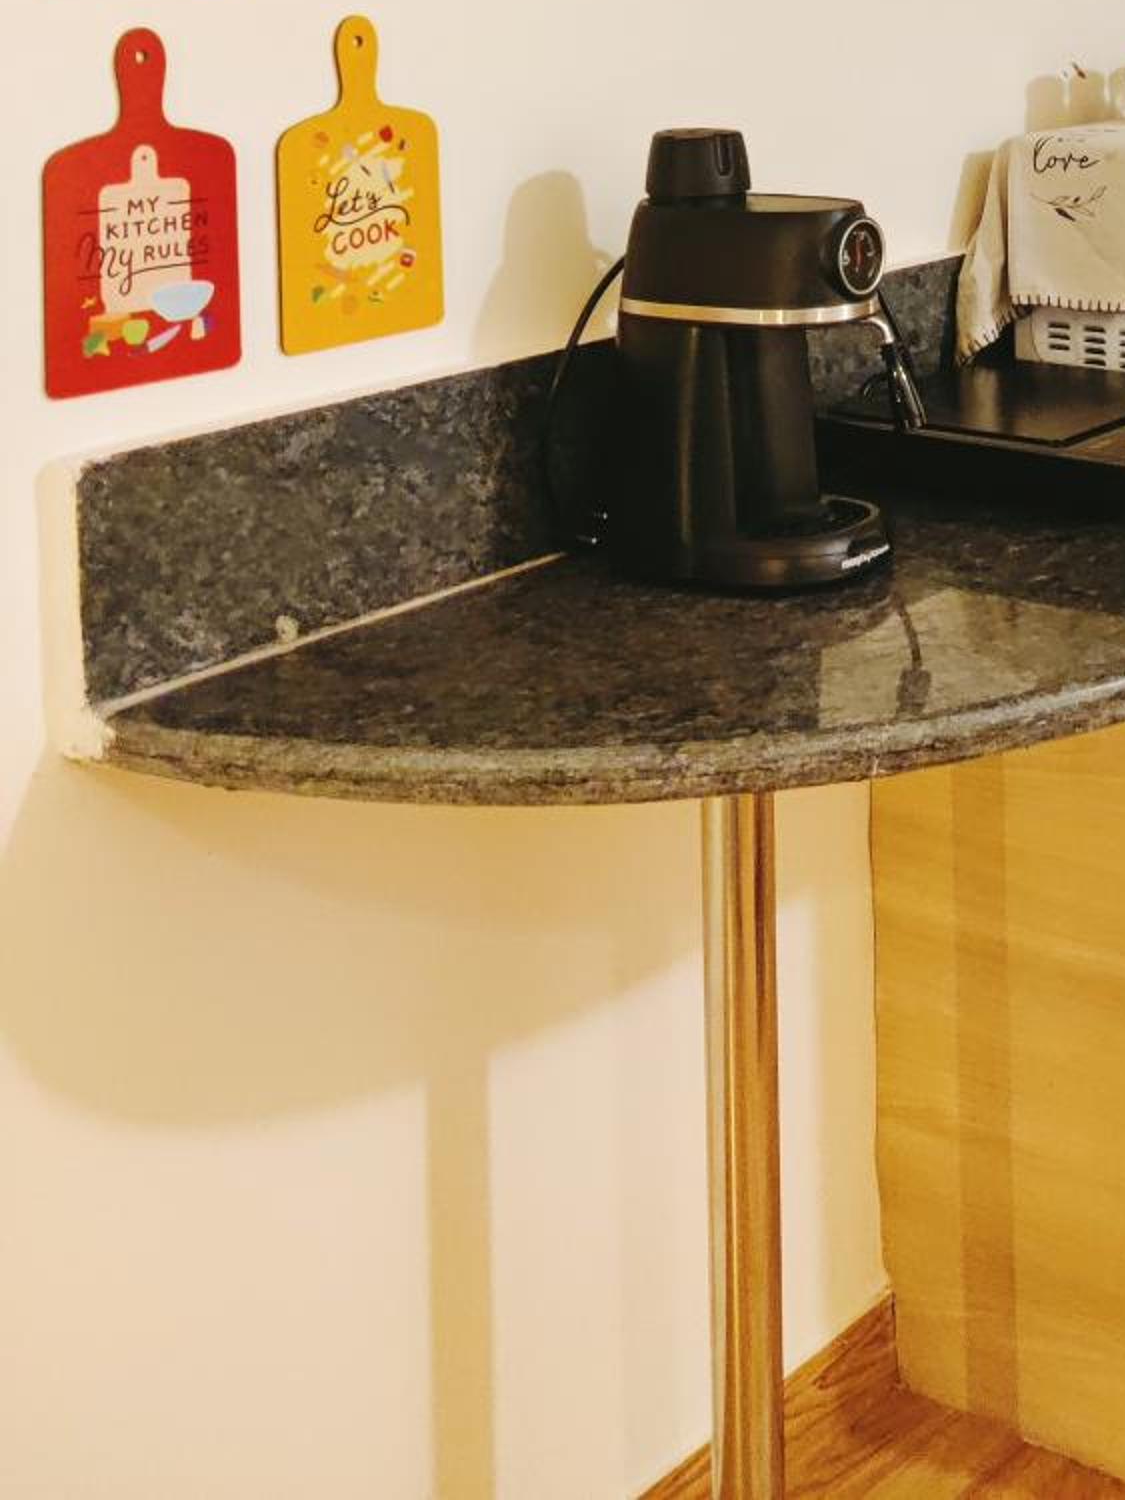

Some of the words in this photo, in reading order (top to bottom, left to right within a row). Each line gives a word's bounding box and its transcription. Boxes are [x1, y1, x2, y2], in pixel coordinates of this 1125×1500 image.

[1033, 136, 1101, 174] Love
[127, 196, 160, 215] MY
[313, 177, 410, 233] Let's
[105, 211, 208, 240] KITCHEN
[332, 218, 400, 255] COOK
[78, 231, 134, 296] My
[143, 236, 208, 263] RULES
